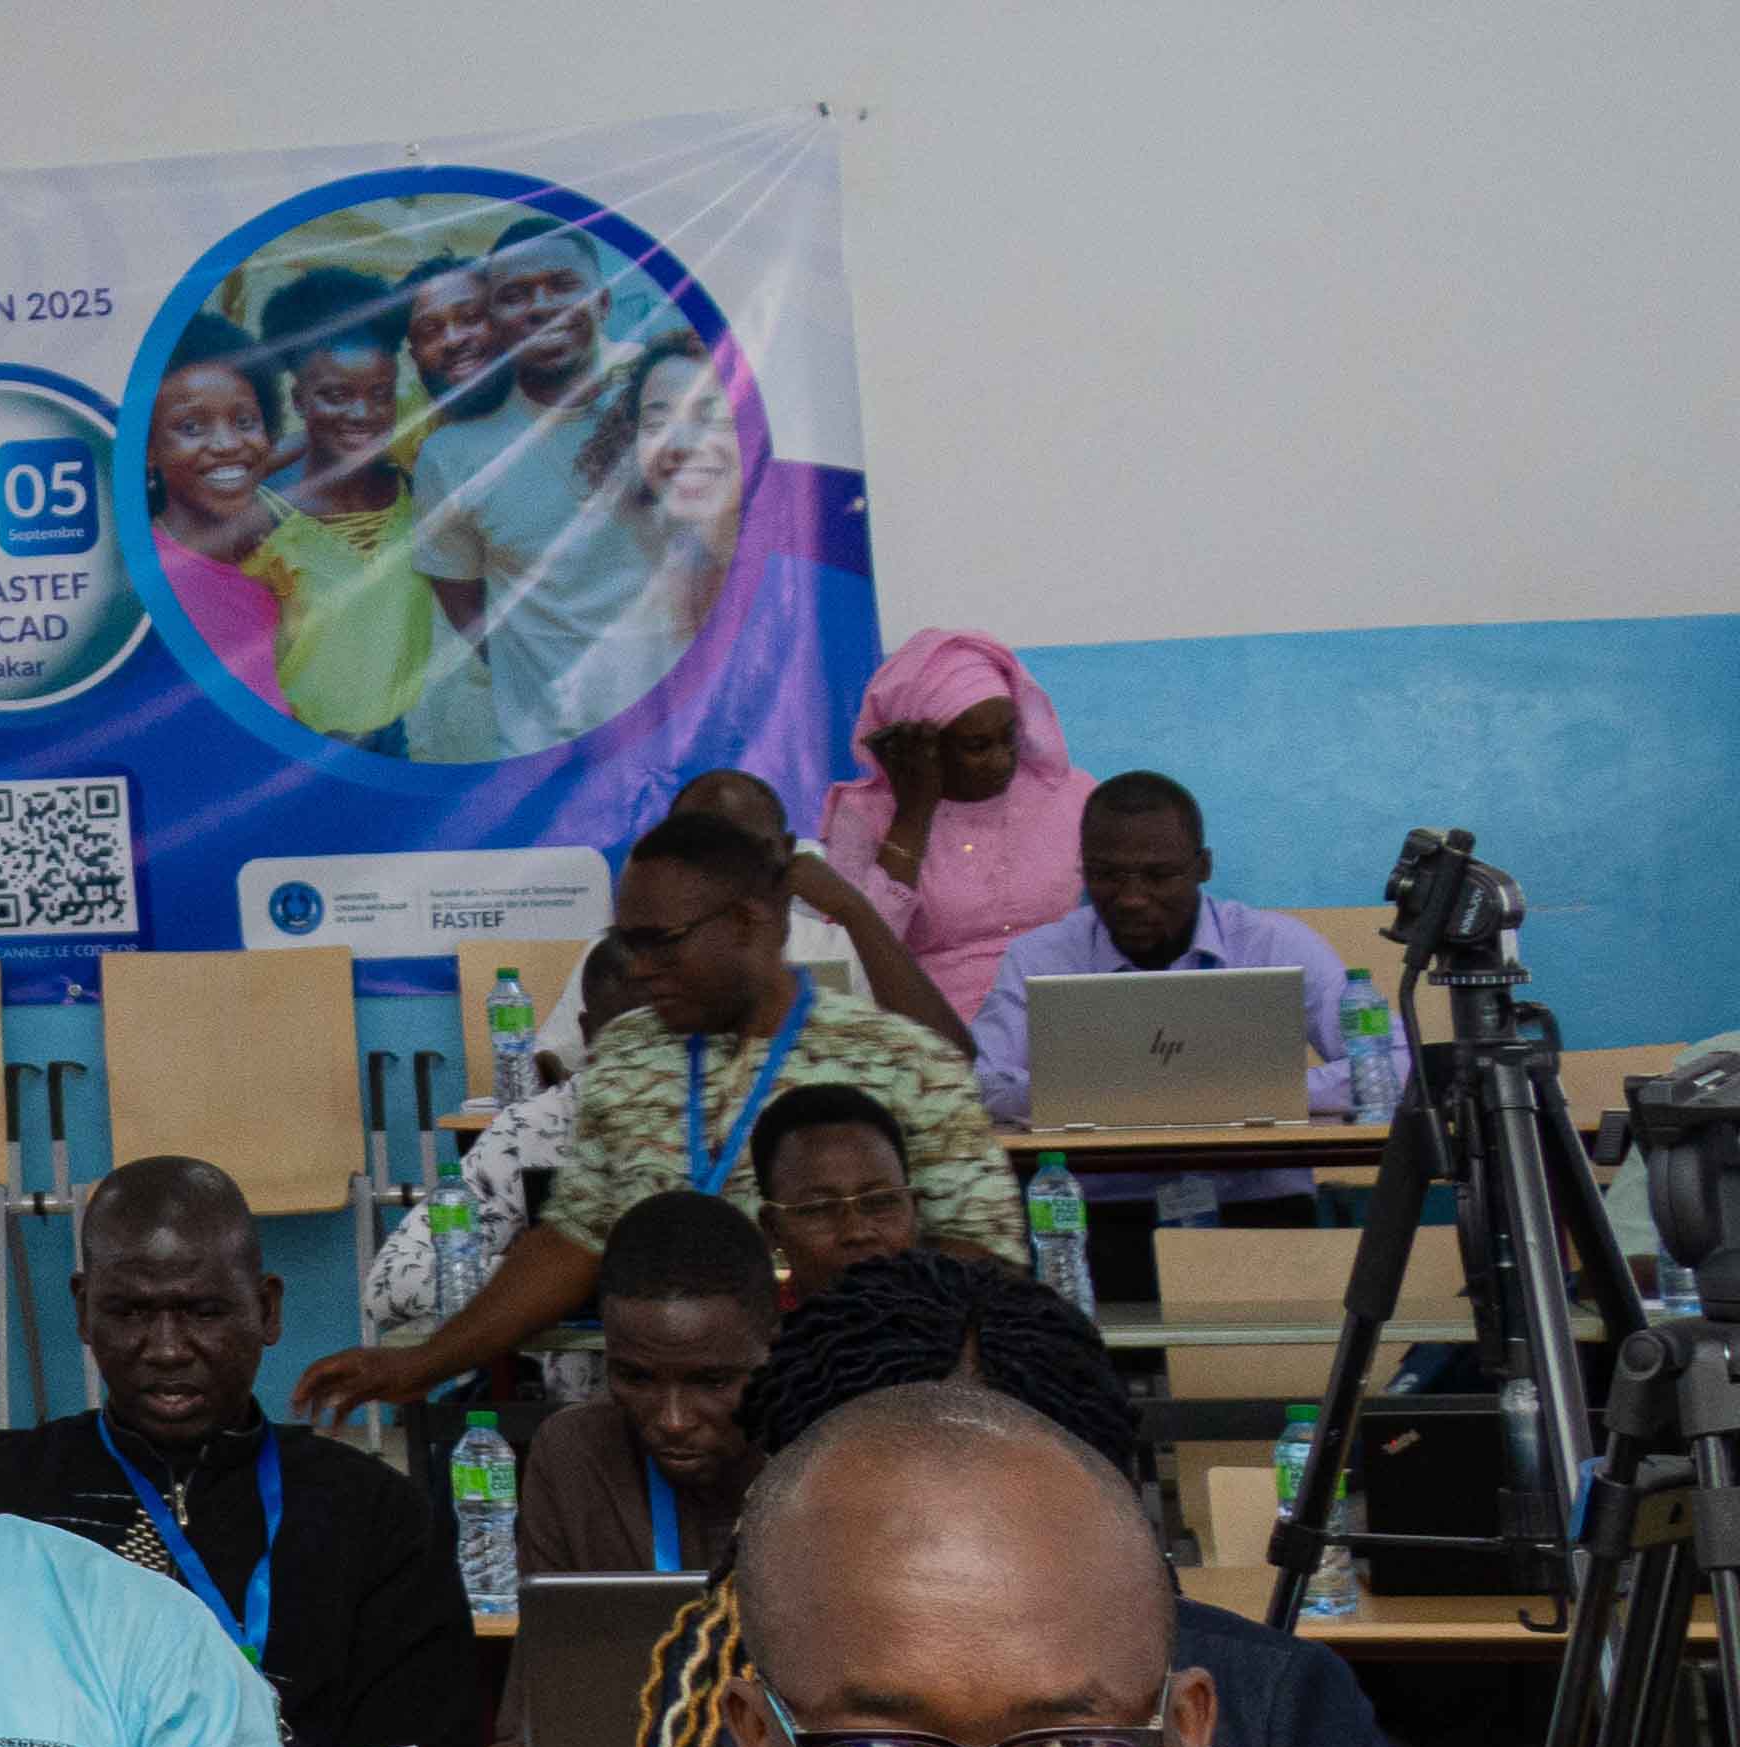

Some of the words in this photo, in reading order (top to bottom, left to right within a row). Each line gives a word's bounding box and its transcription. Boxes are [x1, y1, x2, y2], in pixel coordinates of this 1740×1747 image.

[27, 287, 113, 321] 2025
[4, 461, 87, 519] 05
[9, 526, 85, 542] Septembre
[432, 910, 506, 929] FASTEF
